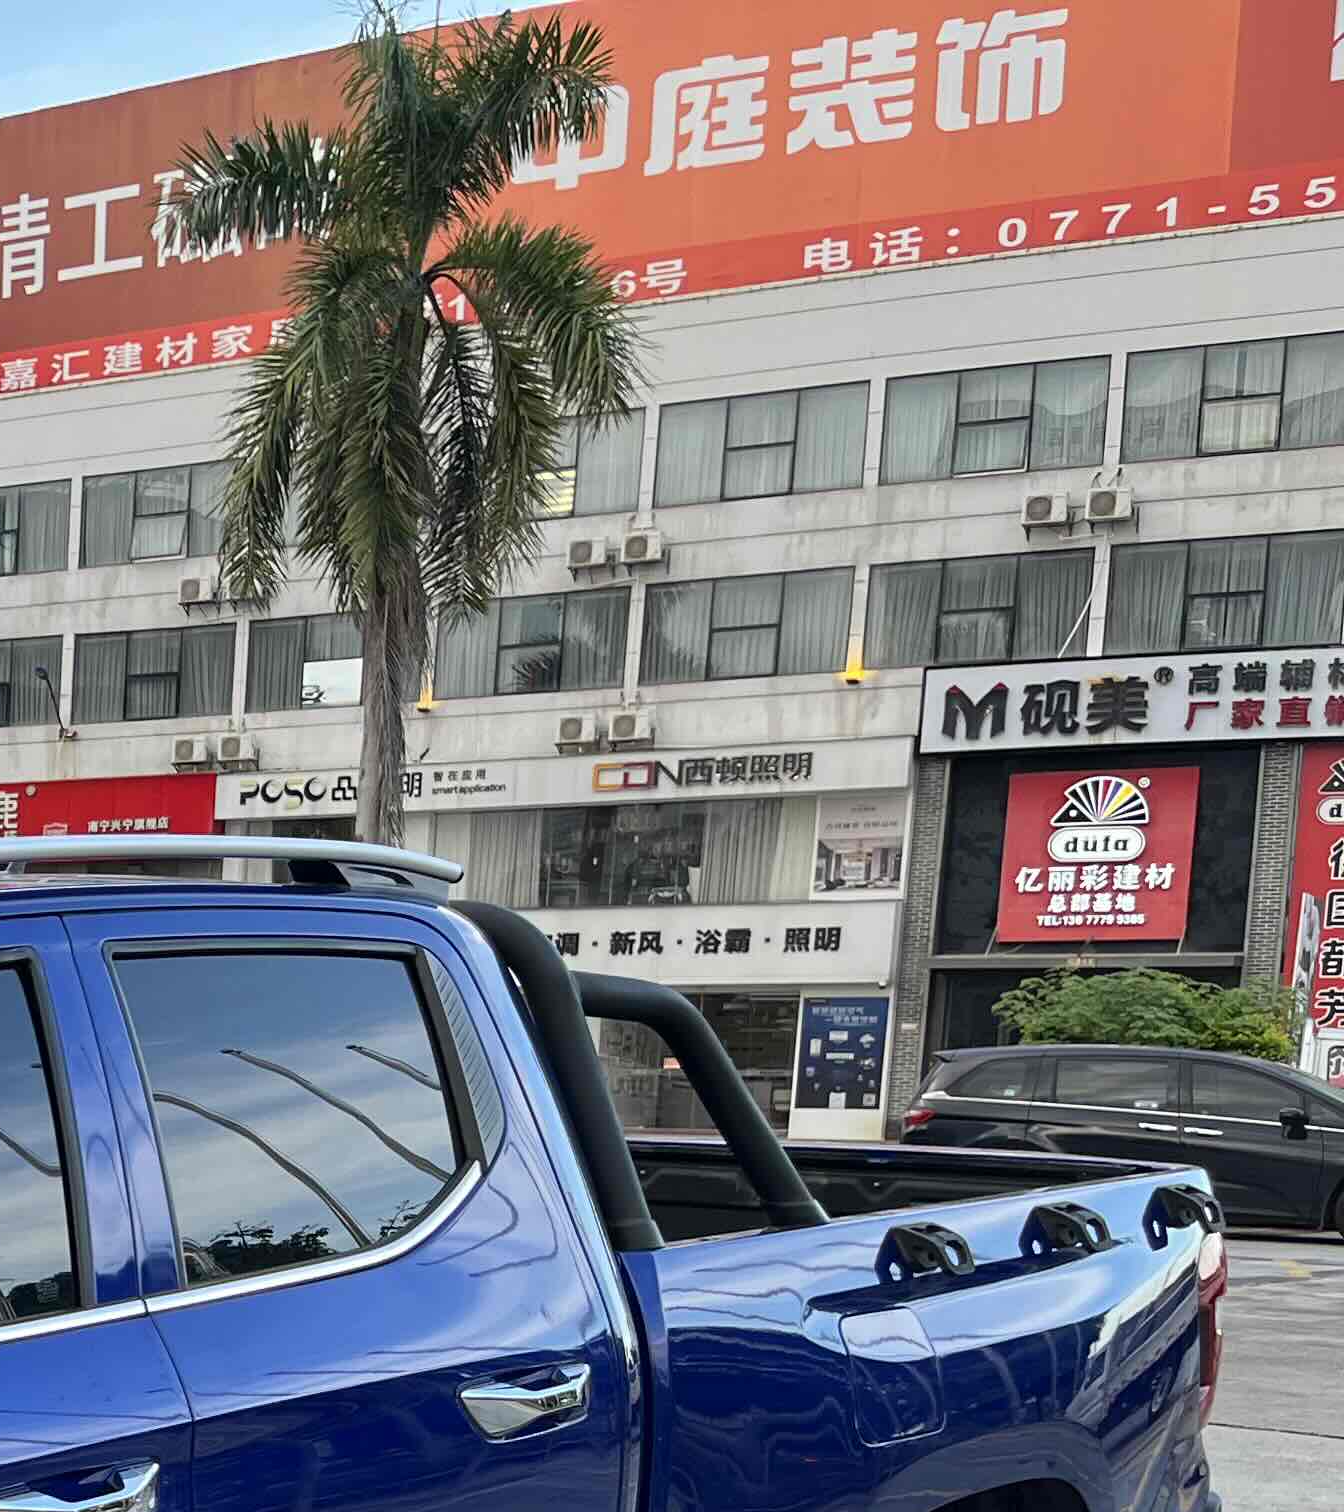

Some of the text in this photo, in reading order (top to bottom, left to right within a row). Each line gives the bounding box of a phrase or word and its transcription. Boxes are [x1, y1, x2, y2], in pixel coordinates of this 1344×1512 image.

[512, 7, 1070, 191] 中庭装饰
[1020, 676, 1150, 736] 砚美
[685, 752, 814, 787] 西顿照明
[458, 784, 507, 796] application
[87, 815, 170, 834] 南宁兴宁旗舰店
[1015, 862, 1176, 894] 亿丽彩建材
[1047, 893, 1137, 914] 总部基地
